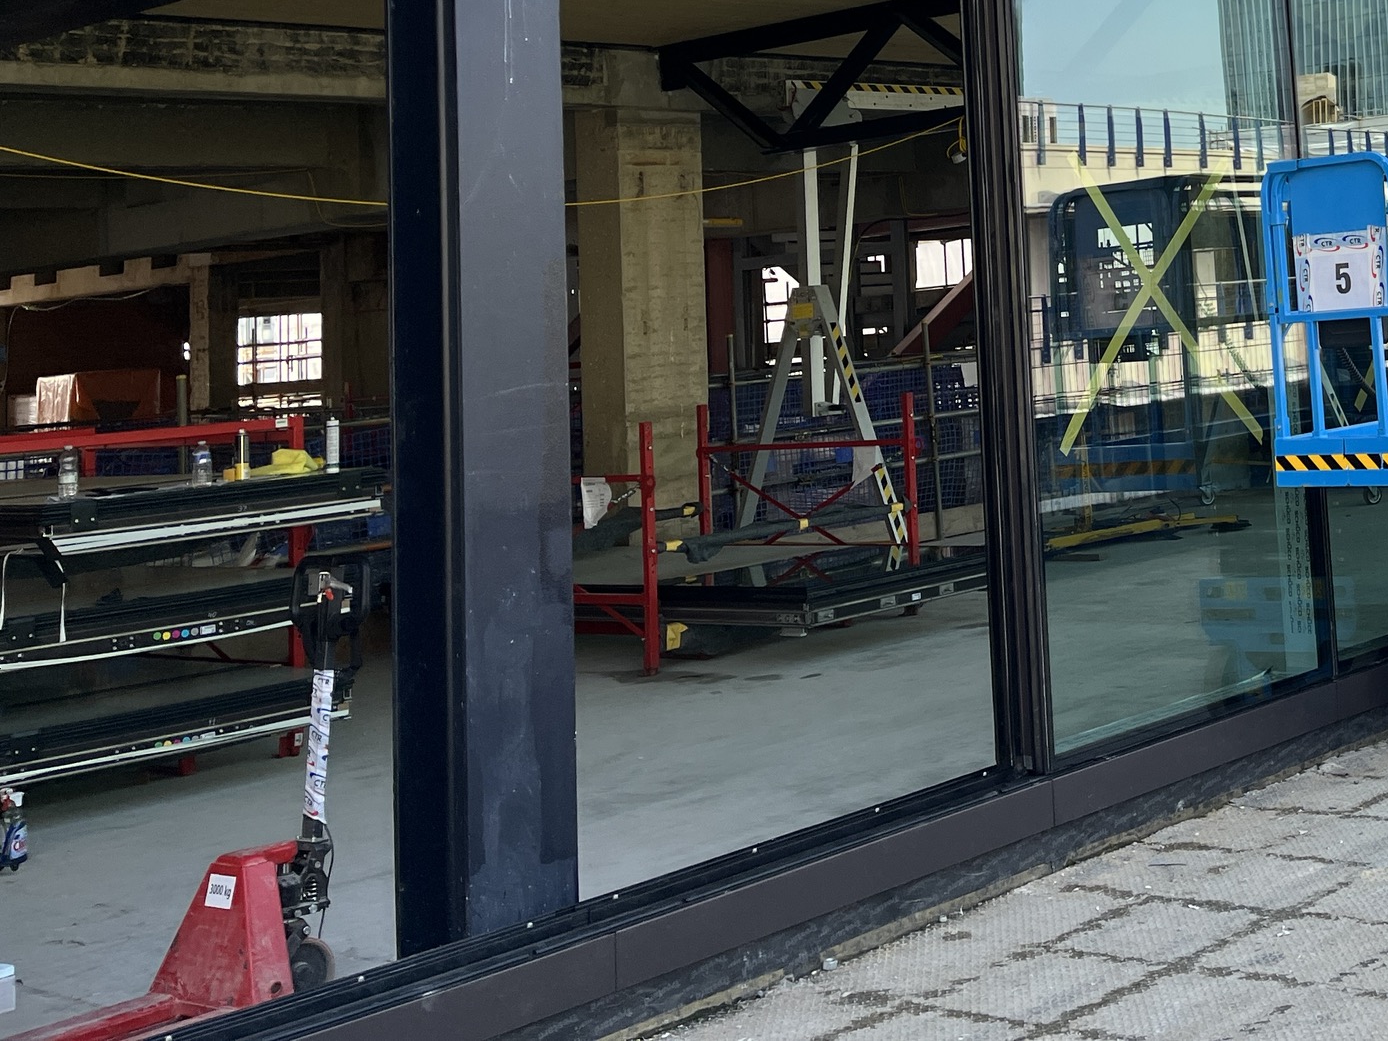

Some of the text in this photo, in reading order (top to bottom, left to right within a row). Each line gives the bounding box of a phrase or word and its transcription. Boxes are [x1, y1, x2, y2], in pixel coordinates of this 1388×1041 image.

[1349, 237, 1361, 245] CTR
[1335, 262, 1352, 294] 5
[311, 730, 323, 743] CTR
[209, 883, 232, 900] 3000 kg
